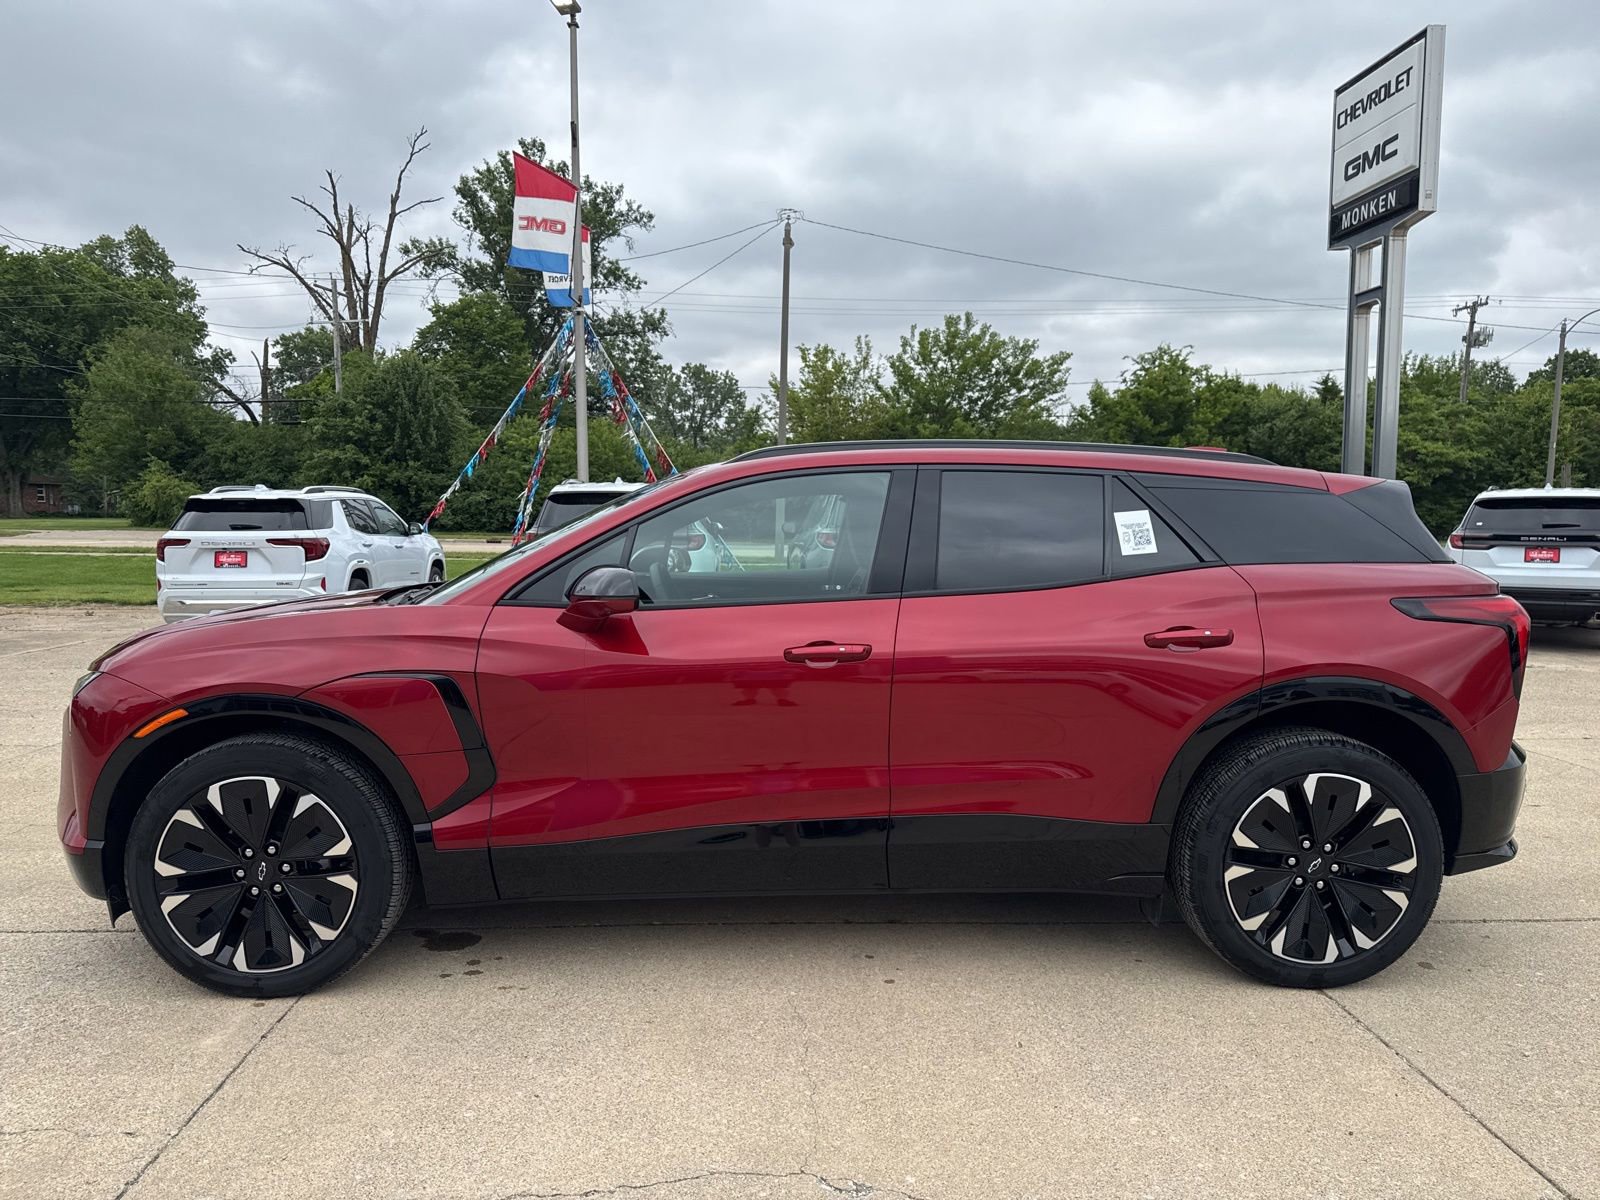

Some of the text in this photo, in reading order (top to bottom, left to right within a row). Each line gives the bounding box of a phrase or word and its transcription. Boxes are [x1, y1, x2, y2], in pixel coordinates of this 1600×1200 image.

[1336, 66, 1414, 130] CHEVROLET
[1343, 133, 1399, 182] GMC
[1341, 189, 1397, 230] MONKEN
